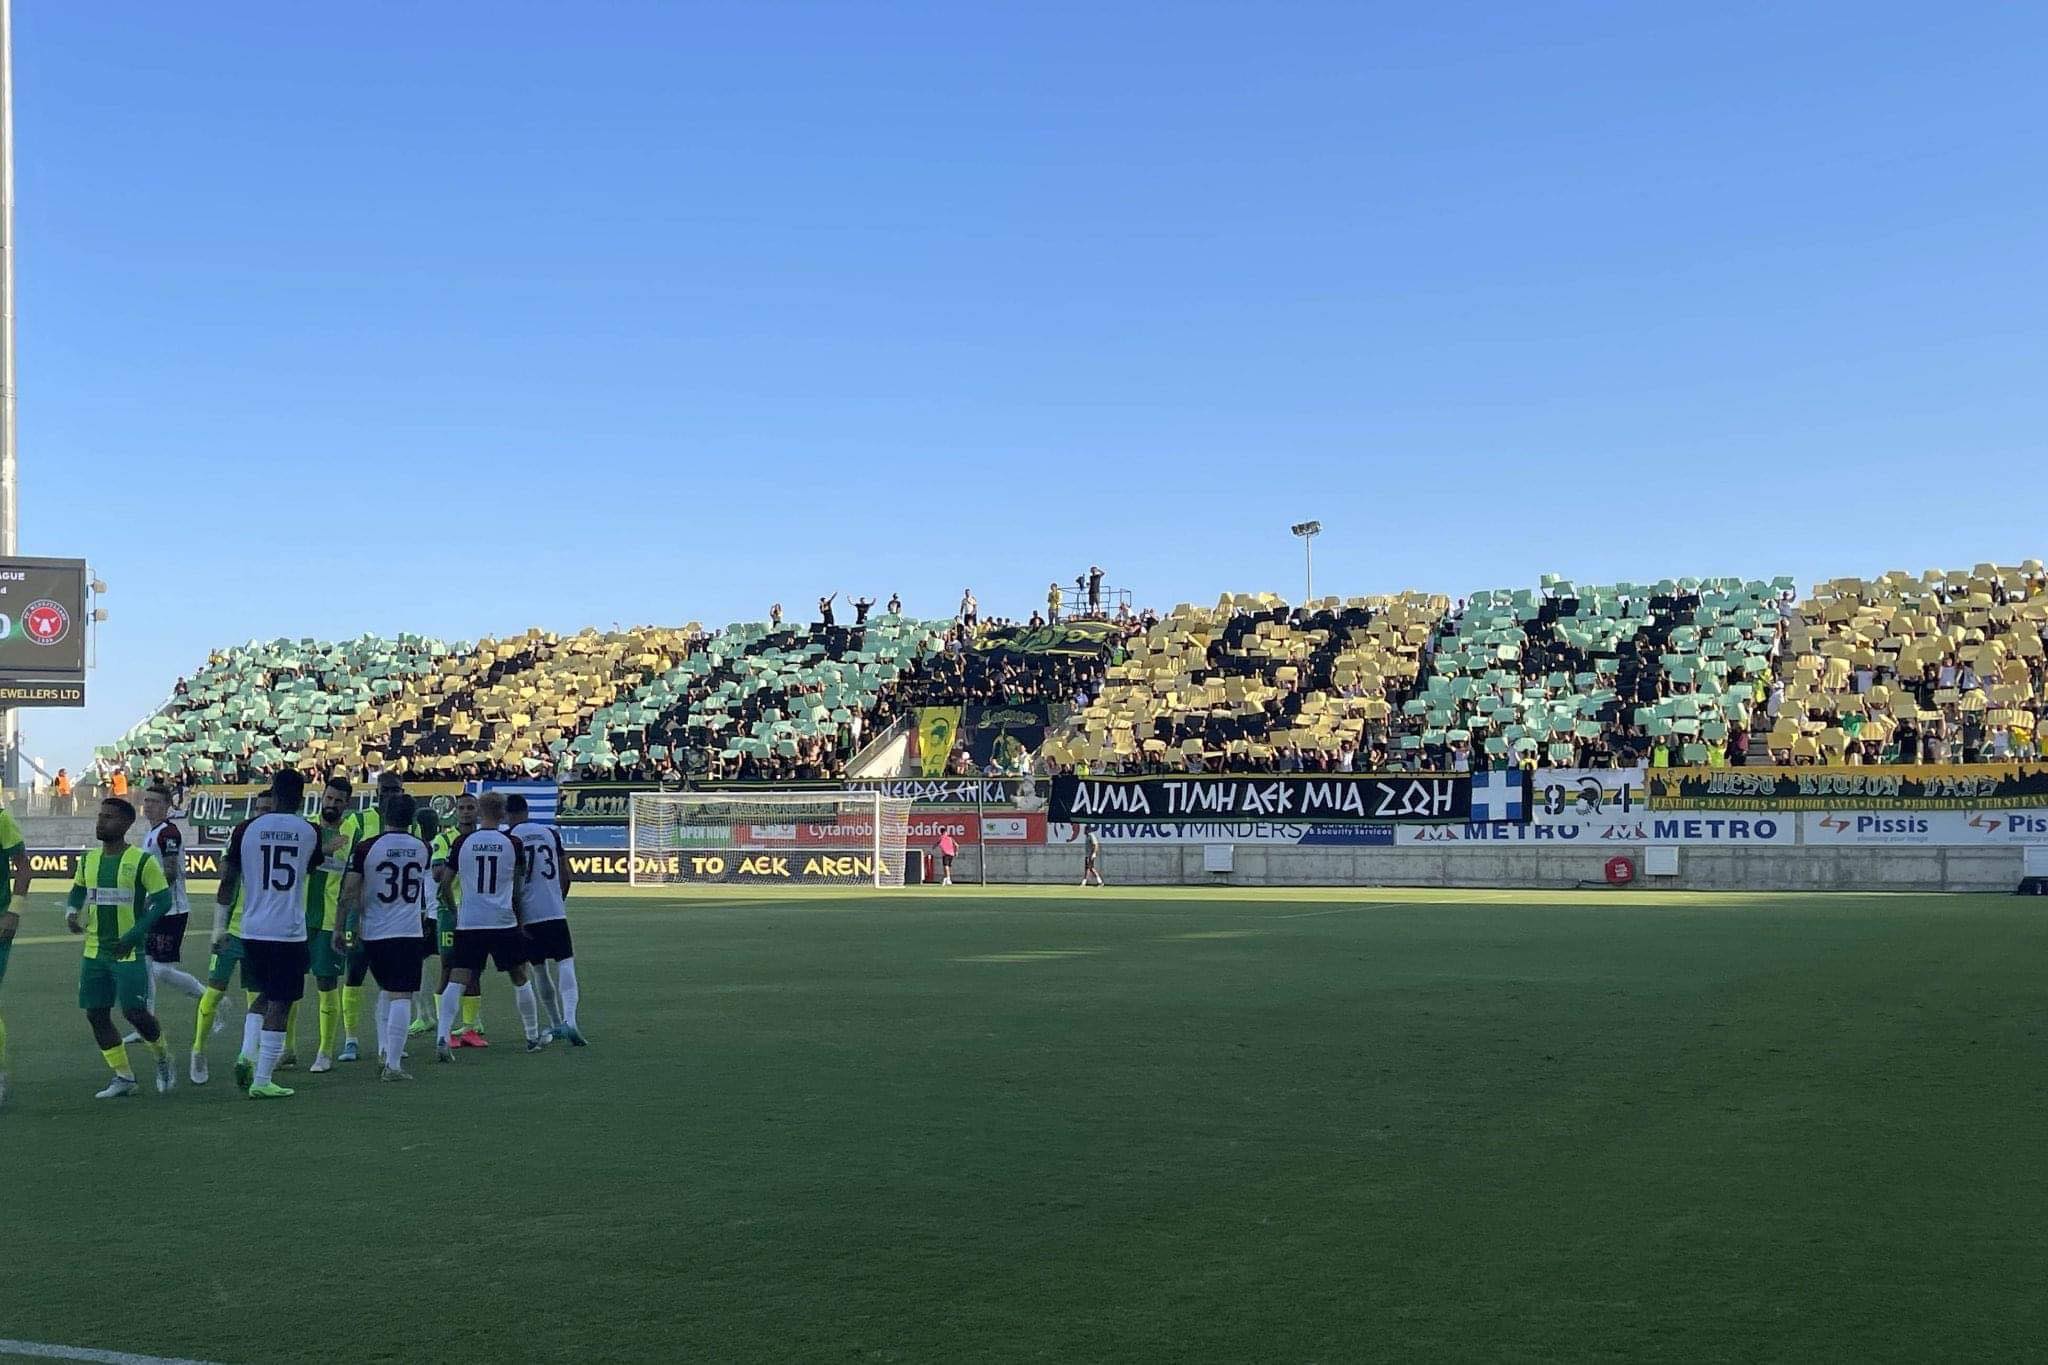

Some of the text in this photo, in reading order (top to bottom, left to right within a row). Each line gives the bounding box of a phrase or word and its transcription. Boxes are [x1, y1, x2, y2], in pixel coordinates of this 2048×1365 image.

[0, 688, 80, 700] EWELLERS LTD
[193, 790, 233, 820] ONE
[560, 789, 629, 817] Larn
[809, 822, 893, 839] Cytamobe
[1464, 823, 1580, 840] METRO
[1654, 819, 1777, 839] METRO
[1857, 815, 1929, 833] Pissis
[2008, 815, 2048, 833] Pis
[260, 844, 299, 891] 15
[476, 855, 498, 894] 11
[568, 855, 891, 877] WELCOME TO AEK ARENA
[375, 861, 423, 904] 36
[441, 931, 454, 947] 16
